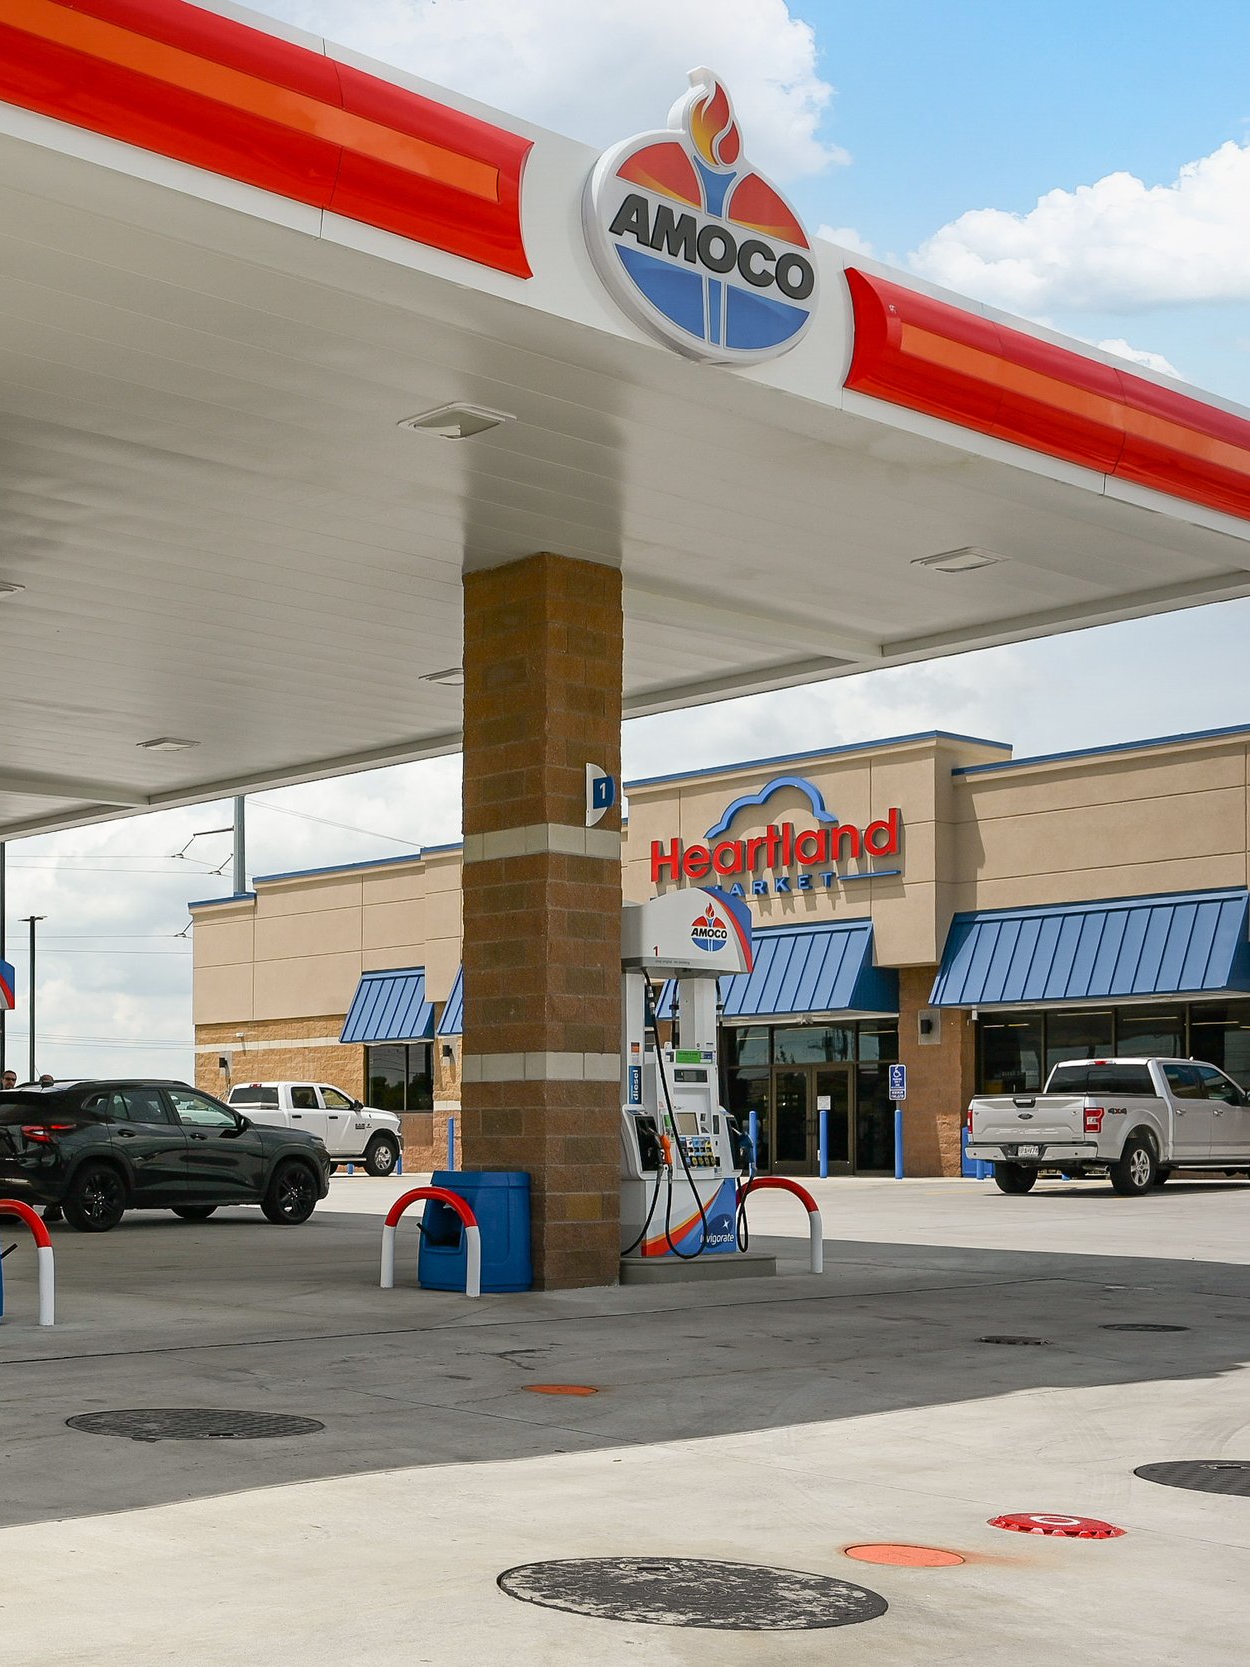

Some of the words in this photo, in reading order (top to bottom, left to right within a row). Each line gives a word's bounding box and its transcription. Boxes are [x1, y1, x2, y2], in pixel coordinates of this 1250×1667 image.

[608, 193, 815, 300] AMOCO
[599, 782, 606, 800] 1
[650, 807, 901, 882] Heartland
[706, 871, 836, 898] ARKET
[691, 927, 728, 939] AMOCO
[653, 945, 658, 957] 1
[700, 1233, 735, 1245] Ivigorate
